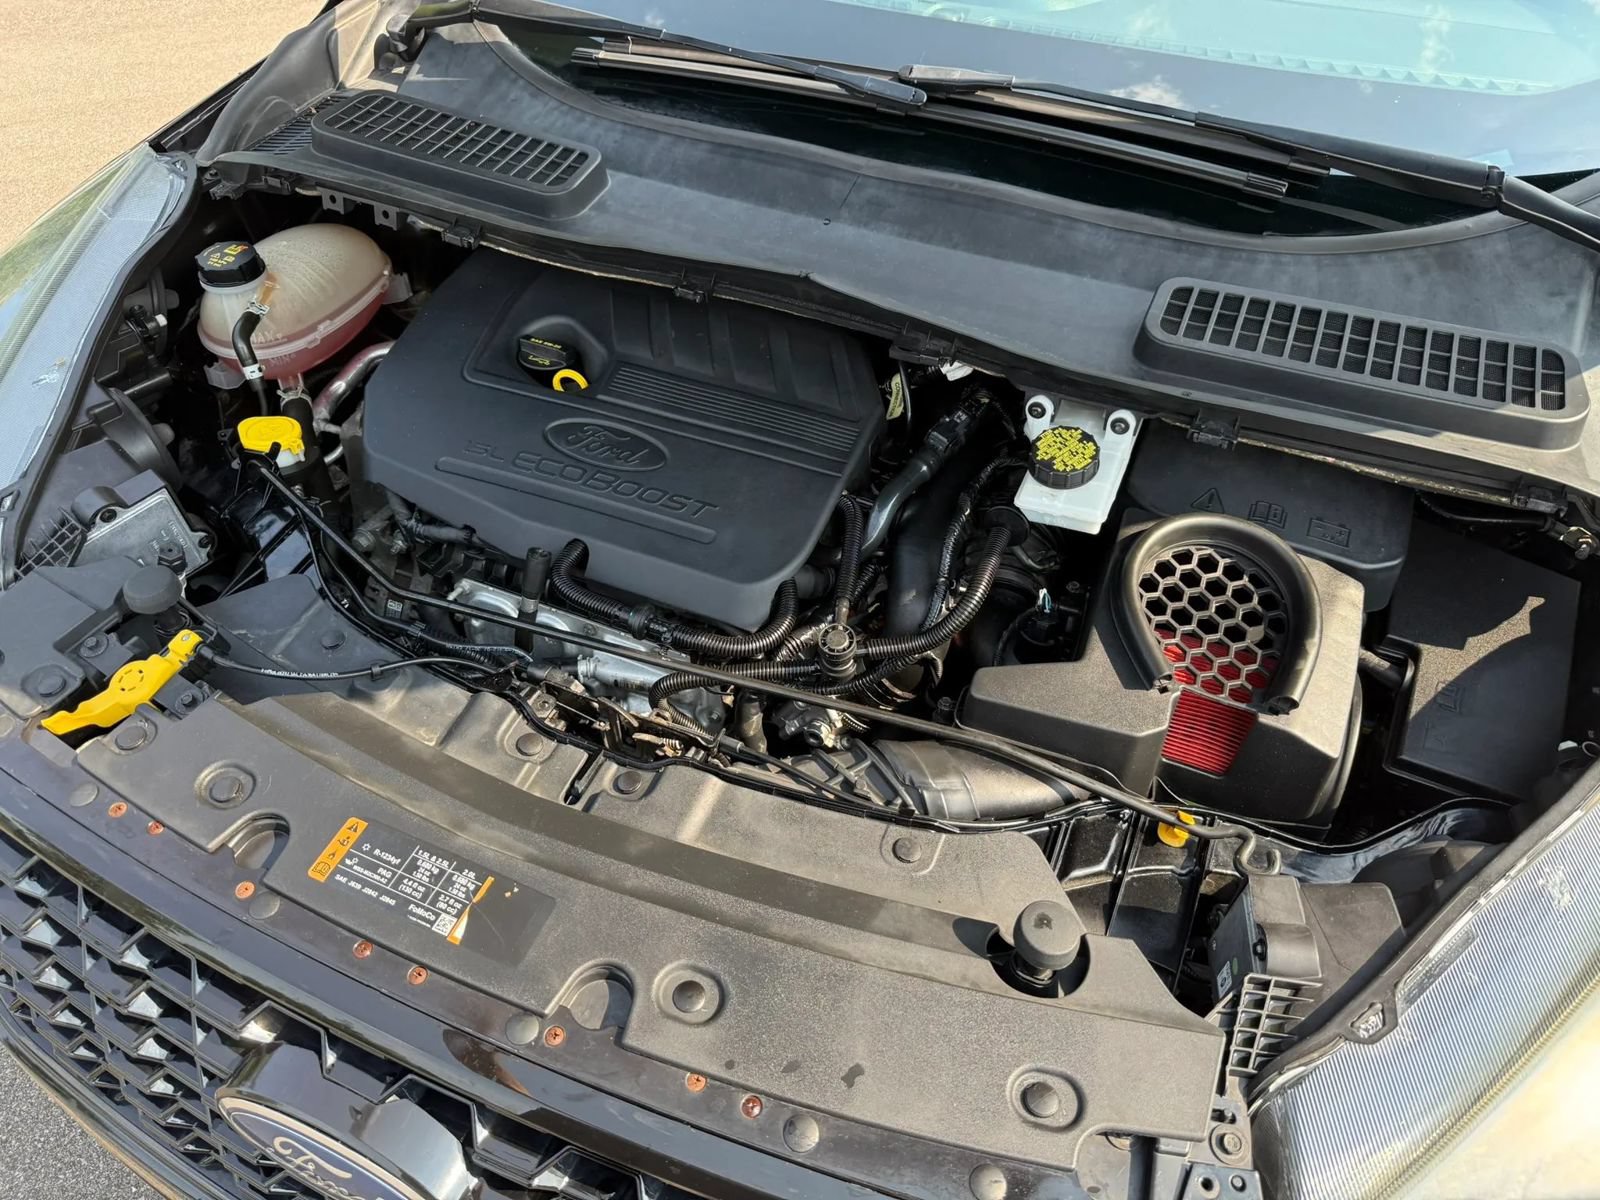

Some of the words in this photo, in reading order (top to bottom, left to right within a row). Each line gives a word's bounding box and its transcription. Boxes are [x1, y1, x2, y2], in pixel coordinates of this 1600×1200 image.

[567, 424, 649, 465] Ford
[377, 867, 392, 879] PAG
[408, 903, 436, 921] FoMoCo
